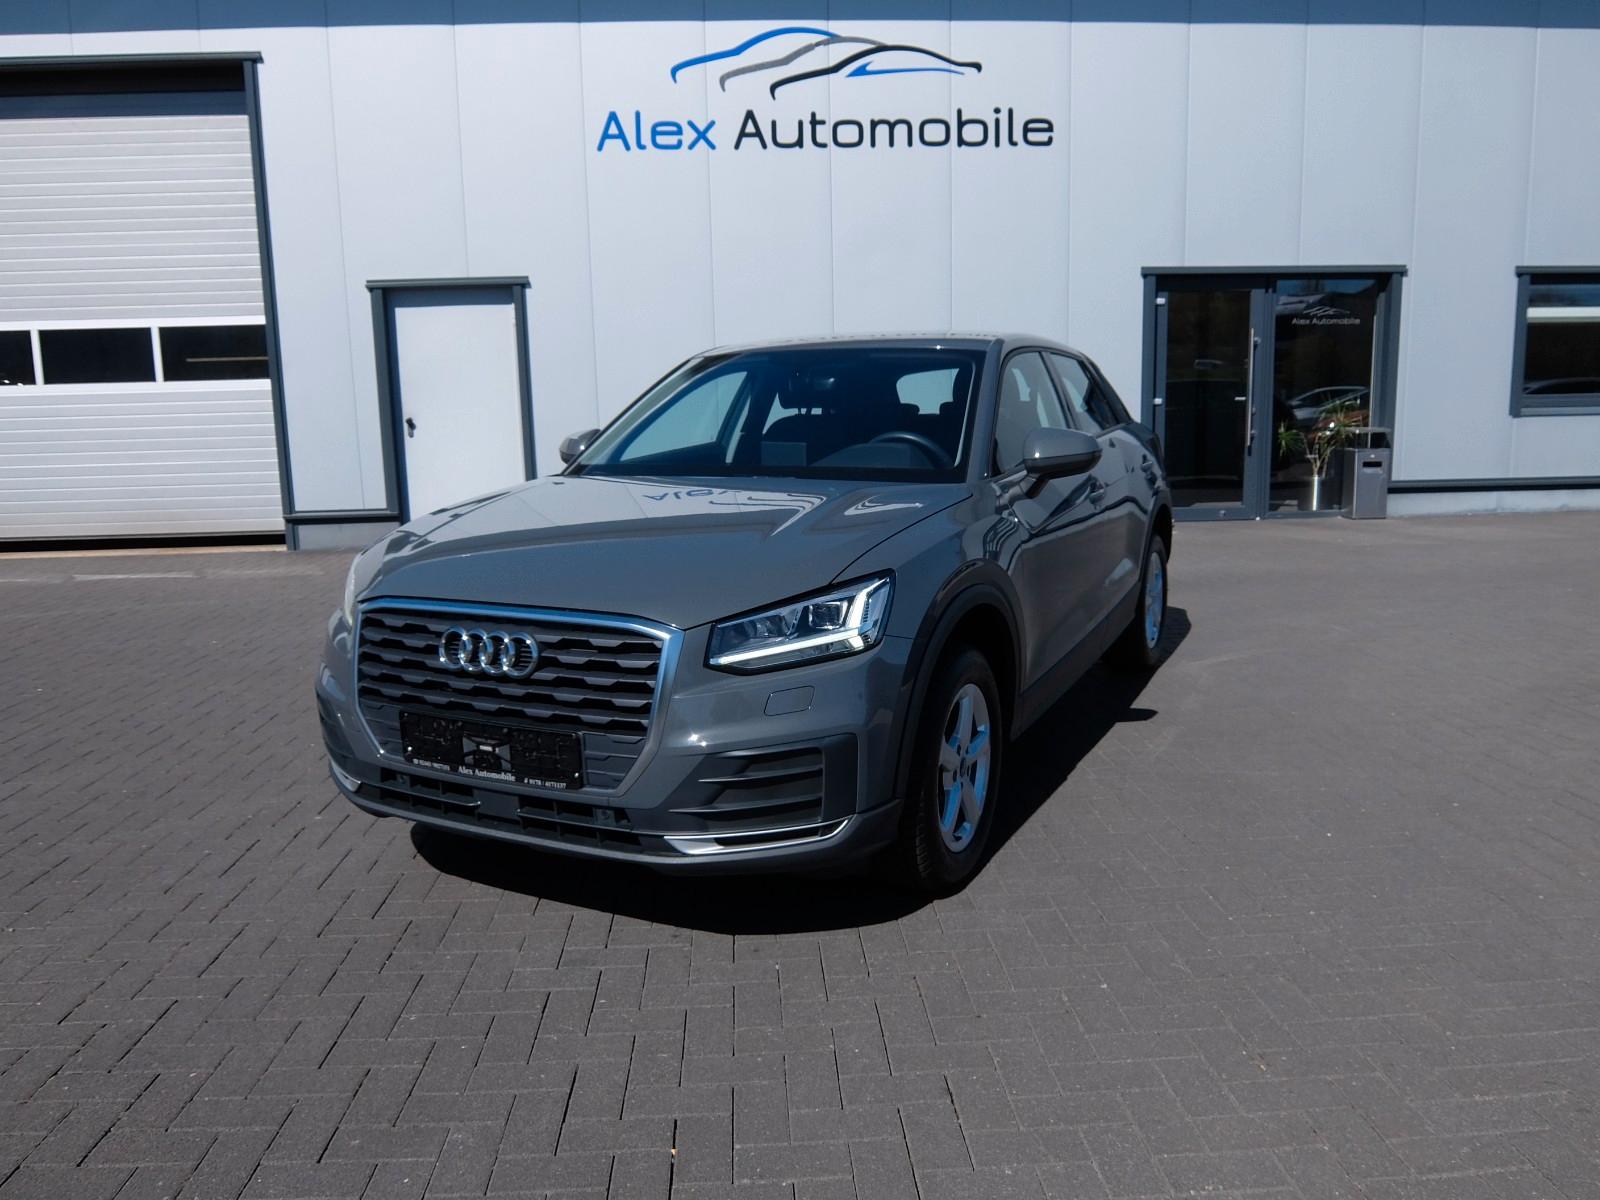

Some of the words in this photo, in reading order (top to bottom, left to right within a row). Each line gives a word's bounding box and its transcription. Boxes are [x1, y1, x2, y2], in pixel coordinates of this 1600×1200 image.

[597, 110, 717, 152] Alex
[734, 107, 1054, 149] Automobile
[1291, 317, 1310, 325] Alex
[1312, 317, 1361, 325] Automobile
[458, 765, 474, 775] Alex
[474, 768, 516, 782] Automobile
